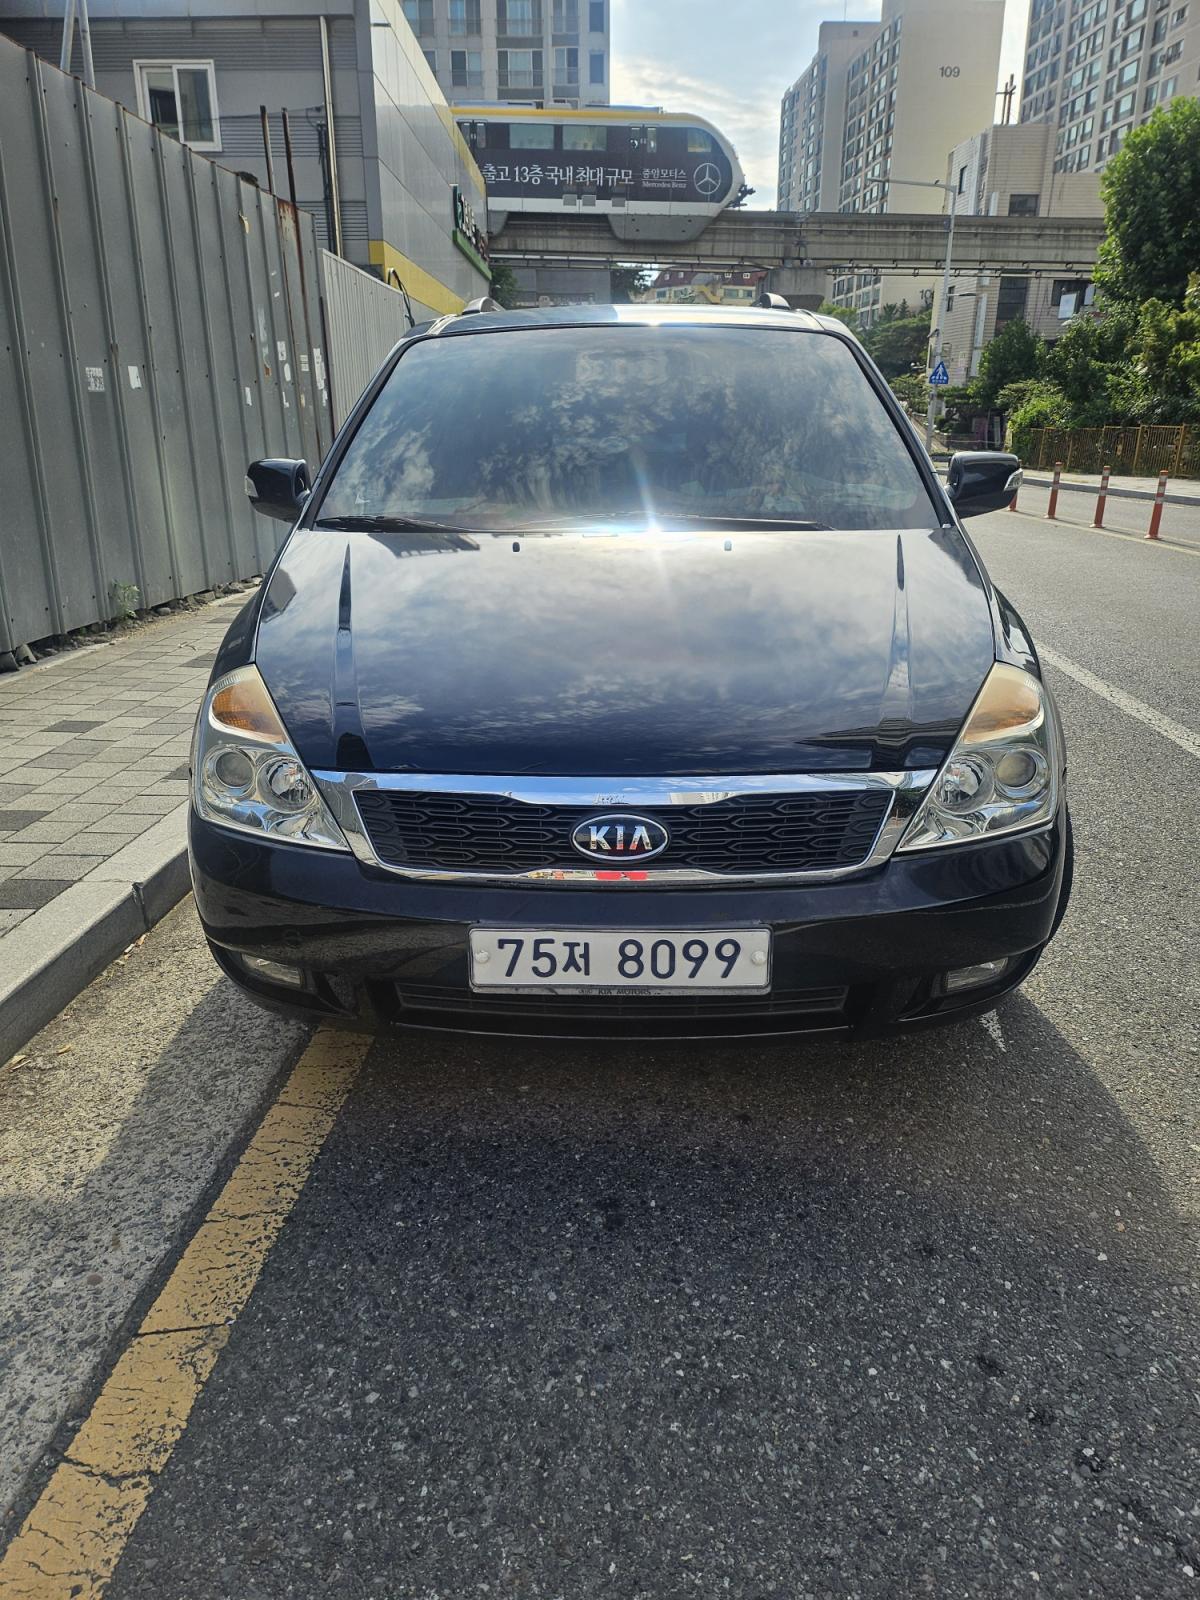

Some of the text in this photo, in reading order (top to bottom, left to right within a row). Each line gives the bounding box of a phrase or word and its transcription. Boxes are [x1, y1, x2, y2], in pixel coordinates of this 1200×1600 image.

[939, 66, 960, 78] 109
[481, 163, 511, 184] 출고
[514, 164, 543, 185] 13층
[544, 165, 573, 186] 국내
[588, 825, 653, 850] KIA
[497, 938, 742, 979] 75저 8099
